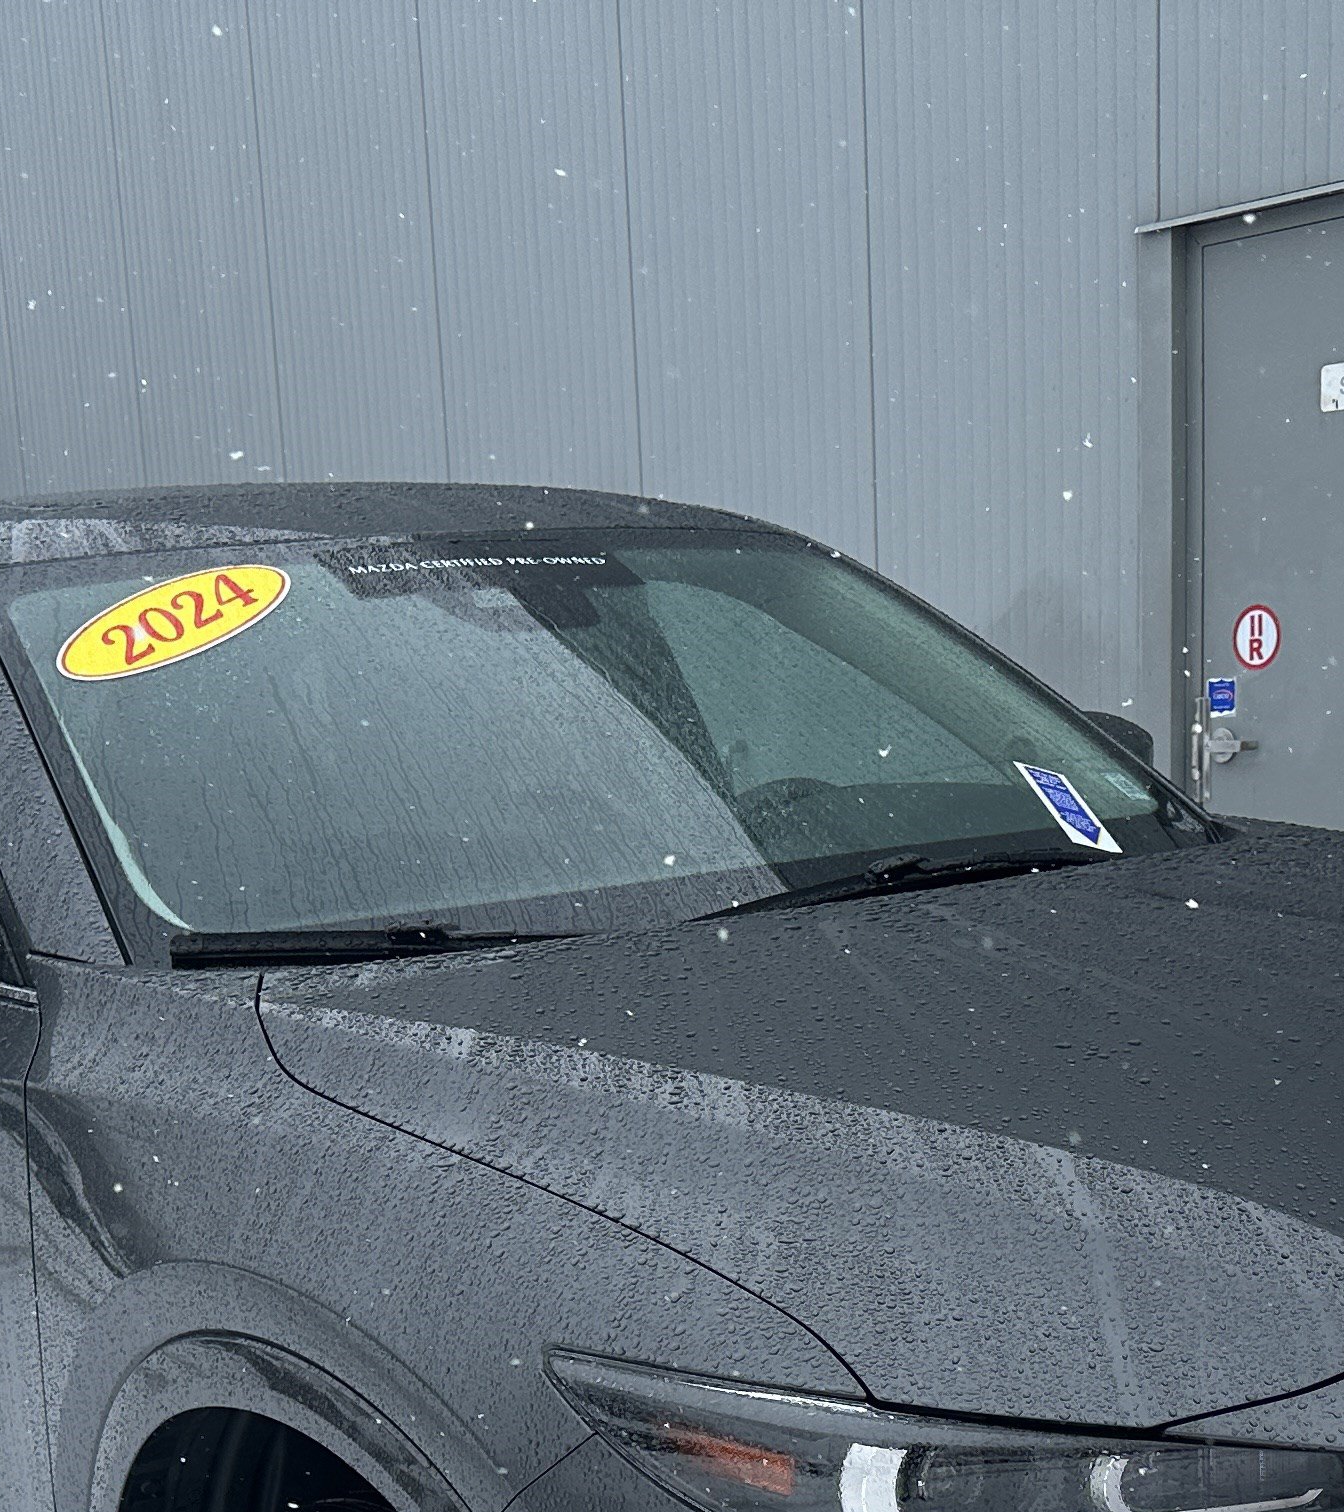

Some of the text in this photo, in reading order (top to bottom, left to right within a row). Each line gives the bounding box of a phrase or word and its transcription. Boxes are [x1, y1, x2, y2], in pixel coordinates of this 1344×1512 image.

[348, 556, 606, 575] MAZDA CERTIFIED PRE-OWNED
[101, 573, 259, 666] 2024
